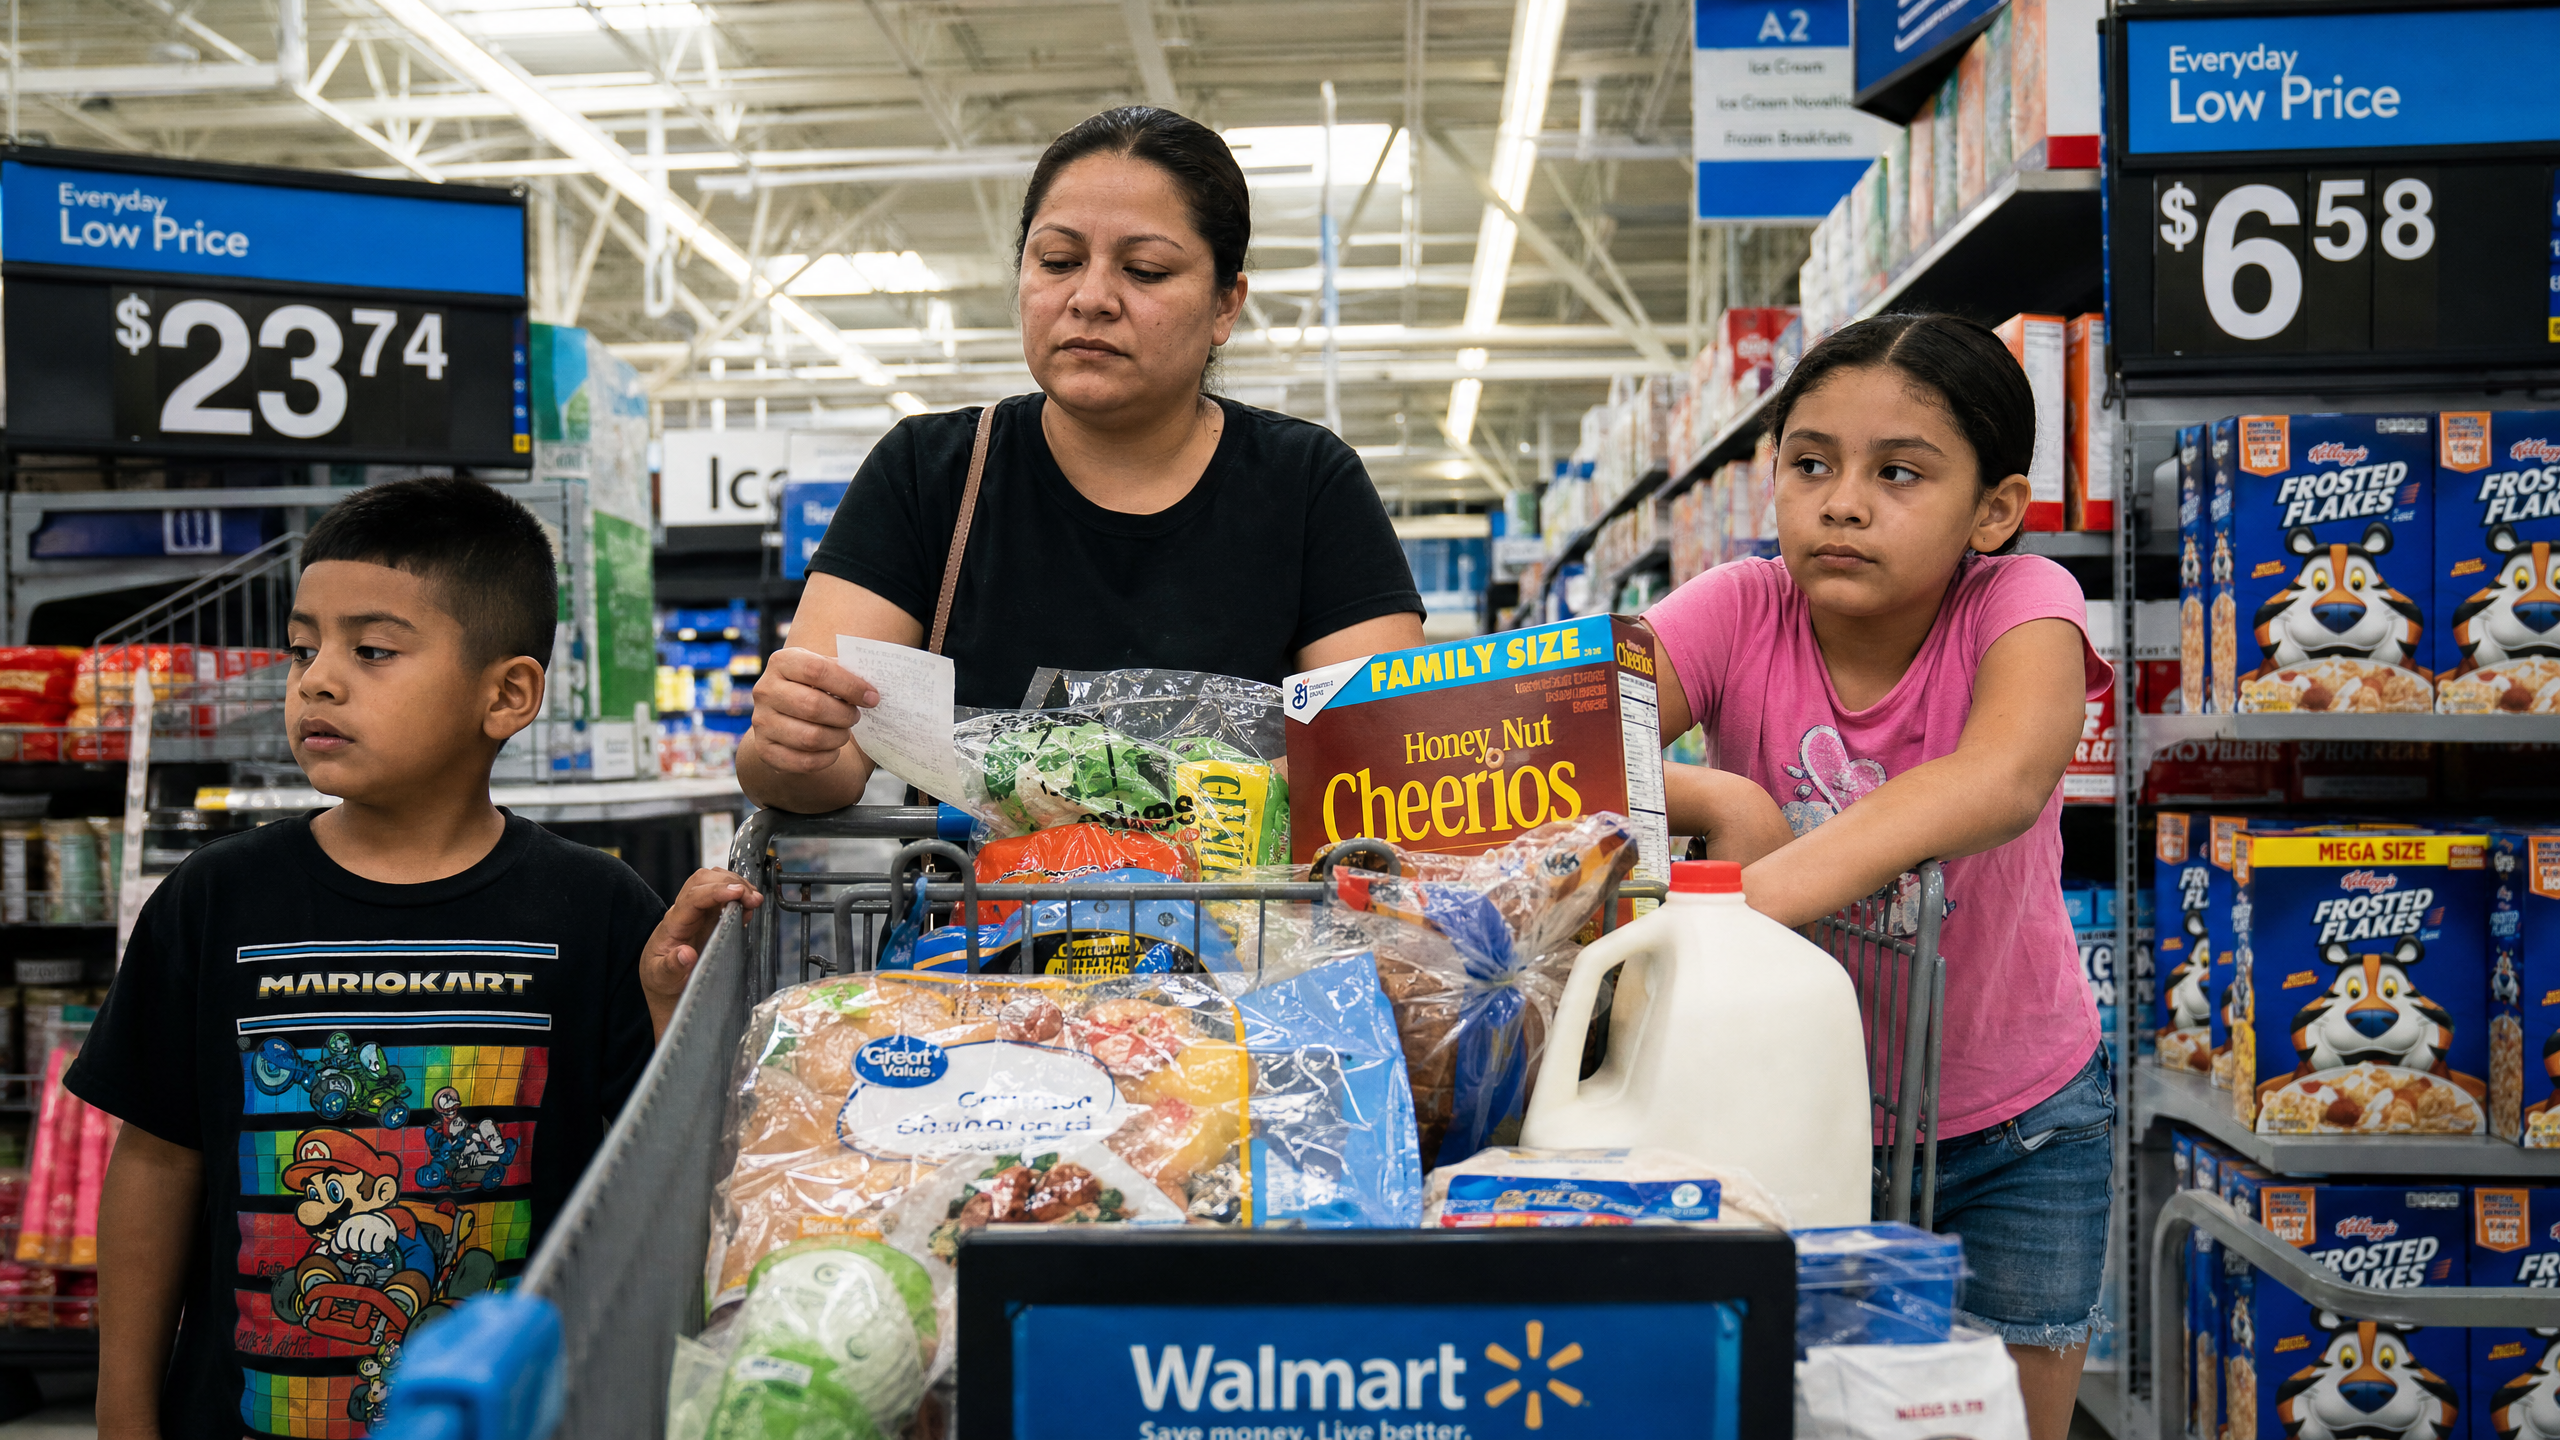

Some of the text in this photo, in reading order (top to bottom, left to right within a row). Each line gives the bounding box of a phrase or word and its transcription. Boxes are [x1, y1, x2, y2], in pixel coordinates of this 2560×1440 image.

[1757, 9, 1811, 43] A2
[2169, 43, 2299, 79] Everyday
[2169, 74, 2401, 124] Low Price
[58, 183, 167, 217] Everyday
[59, 208, 249, 258] Low Price
[2308, 441, 2369, 466] Kellogg's
[2277, 461, 2409, 504] FROSTED
[2478, 465, 2560, 501] FROS
[2283, 486, 2396, 527] FLAKES
[1370, 642, 1496, 693] FAMILY
[1506, 627, 1580, 669] SIZE
[1404, 713, 1554, 765] Honey Nut
[1323, 761, 1582, 844] Cheerios
[2319, 842, 2426, 861] MEGA SIZE
[2341, 870, 2398, 895] Kellogg's
[2313, 888, 2434, 924] FROSTED
[2318, 911, 2424, 945] FLAKES
[257, 971, 534, 998] MARIOKART
[863, 1046, 932, 1067] Great
[2335, 1216, 2398, 1241] Kellogg's
[2350, 1263, 2427, 1290] AKES
[1130, 1343, 1467, 1412] Walmart
[1139, 1421, 1203, 1440] Save
[1319, 1420, 1373, 1440] Live
